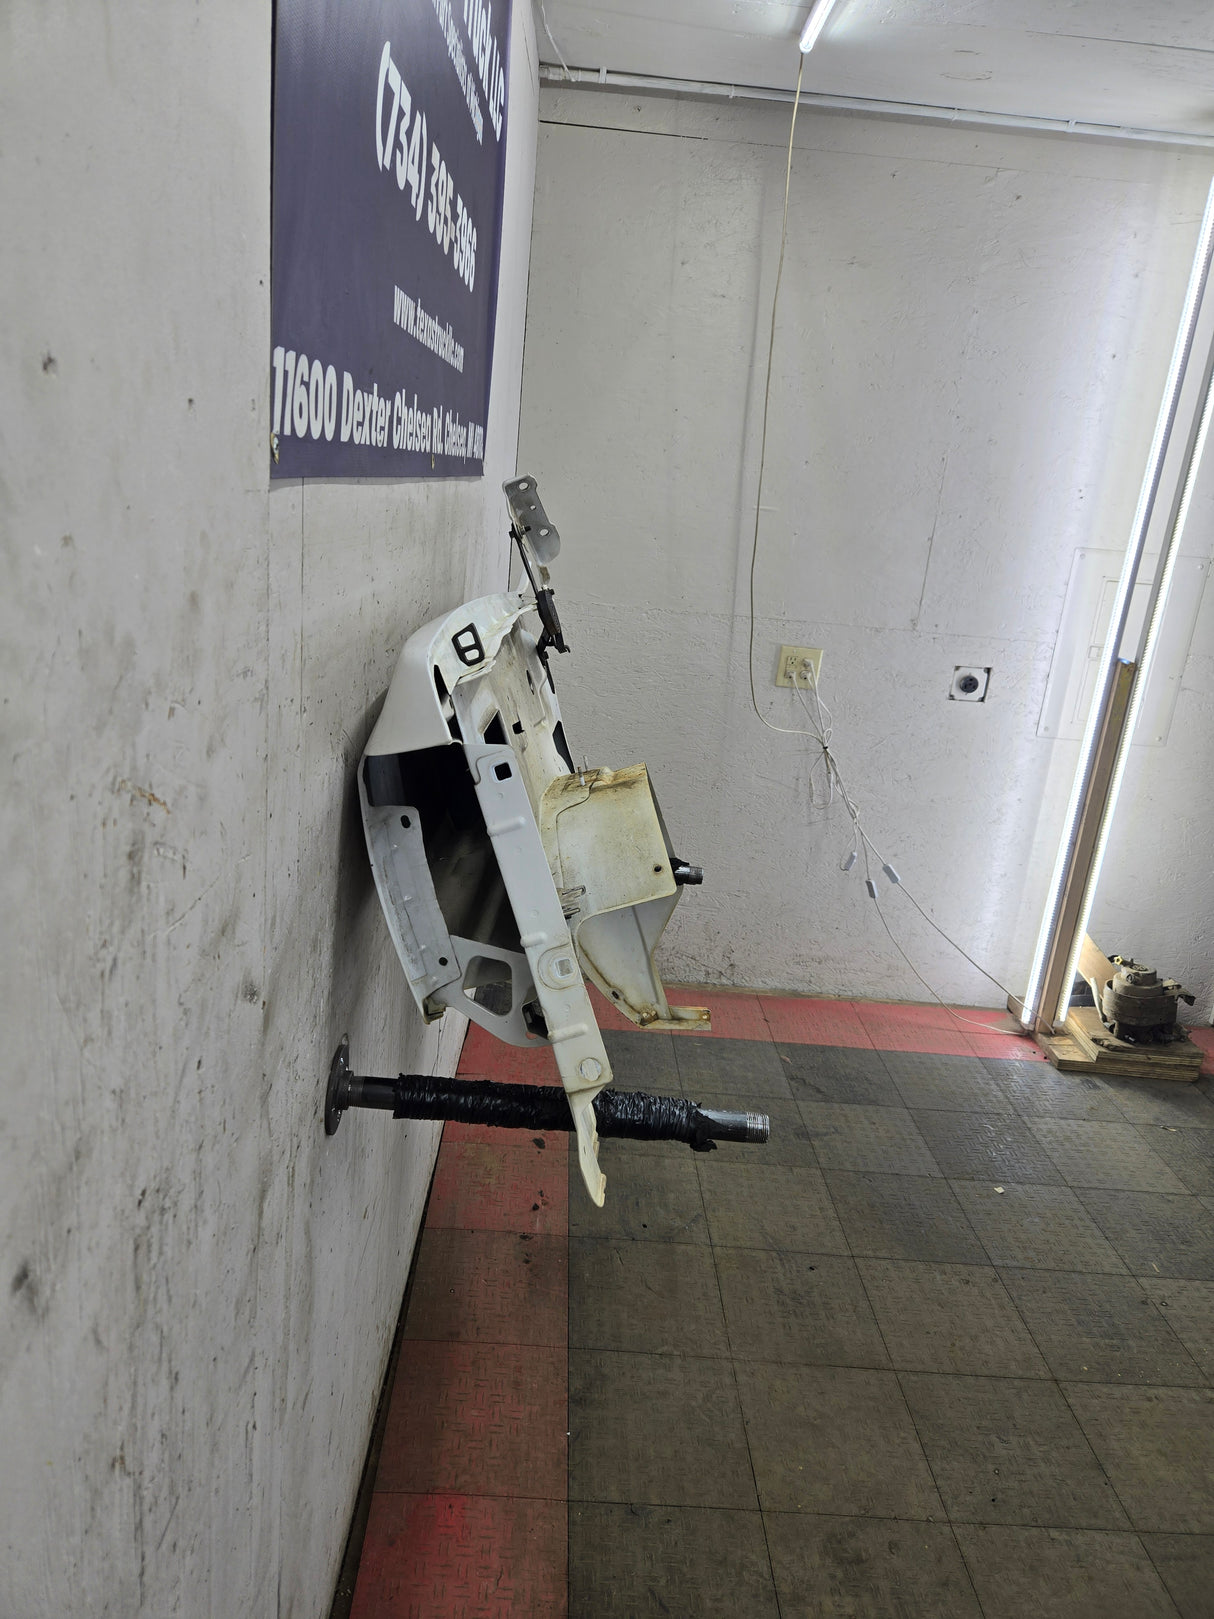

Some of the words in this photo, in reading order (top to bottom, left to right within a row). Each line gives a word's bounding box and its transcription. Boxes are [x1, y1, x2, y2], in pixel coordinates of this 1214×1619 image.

[489, 35, 505, 142] LLC
[376, 40, 428, 222] (734)
[428, 142, 477, 293] 395-3966
[272, 346, 338, 441] 11600
[340, 370, 392, 447] Dexter
[393, 388, 431, 453] Chelsea
[432, 405, 443, 455] Rd.
